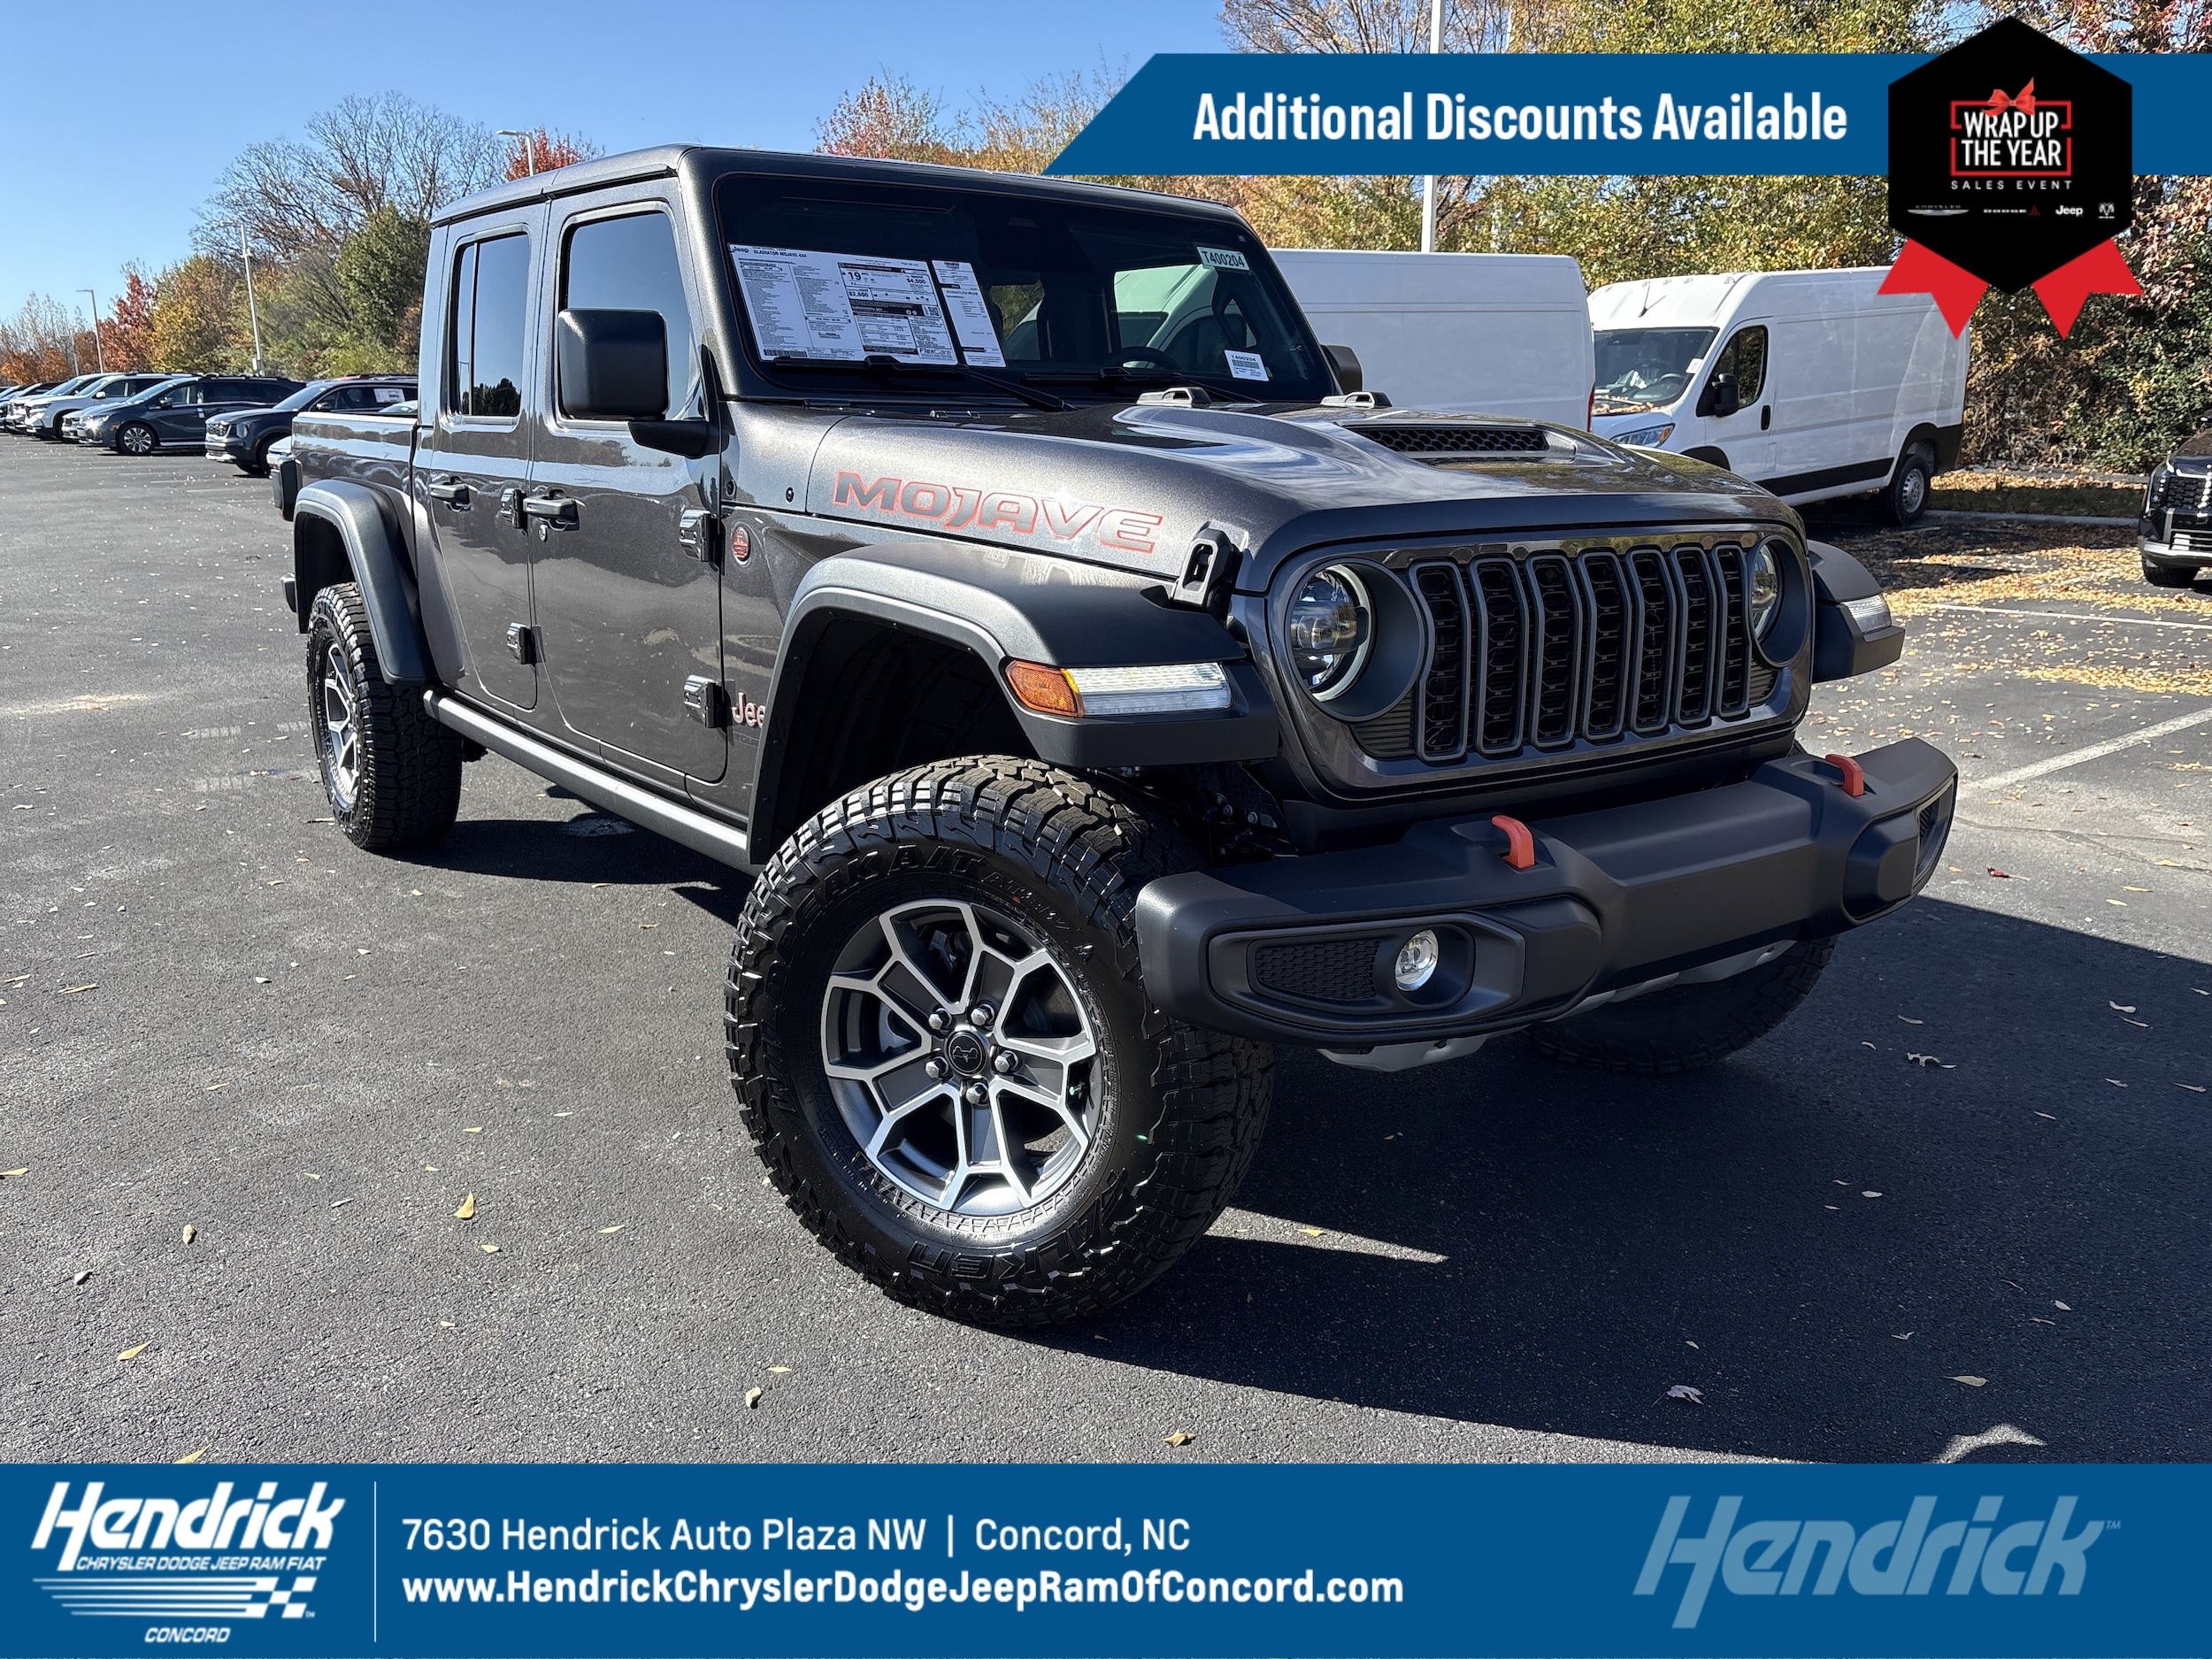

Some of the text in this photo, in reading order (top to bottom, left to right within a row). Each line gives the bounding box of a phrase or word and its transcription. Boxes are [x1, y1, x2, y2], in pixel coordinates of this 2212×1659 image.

[1201, 250, 1246, 268] T400204
[848, 271, 862, 280] 19
[833, 471, 1164, 554] MOJAVE
